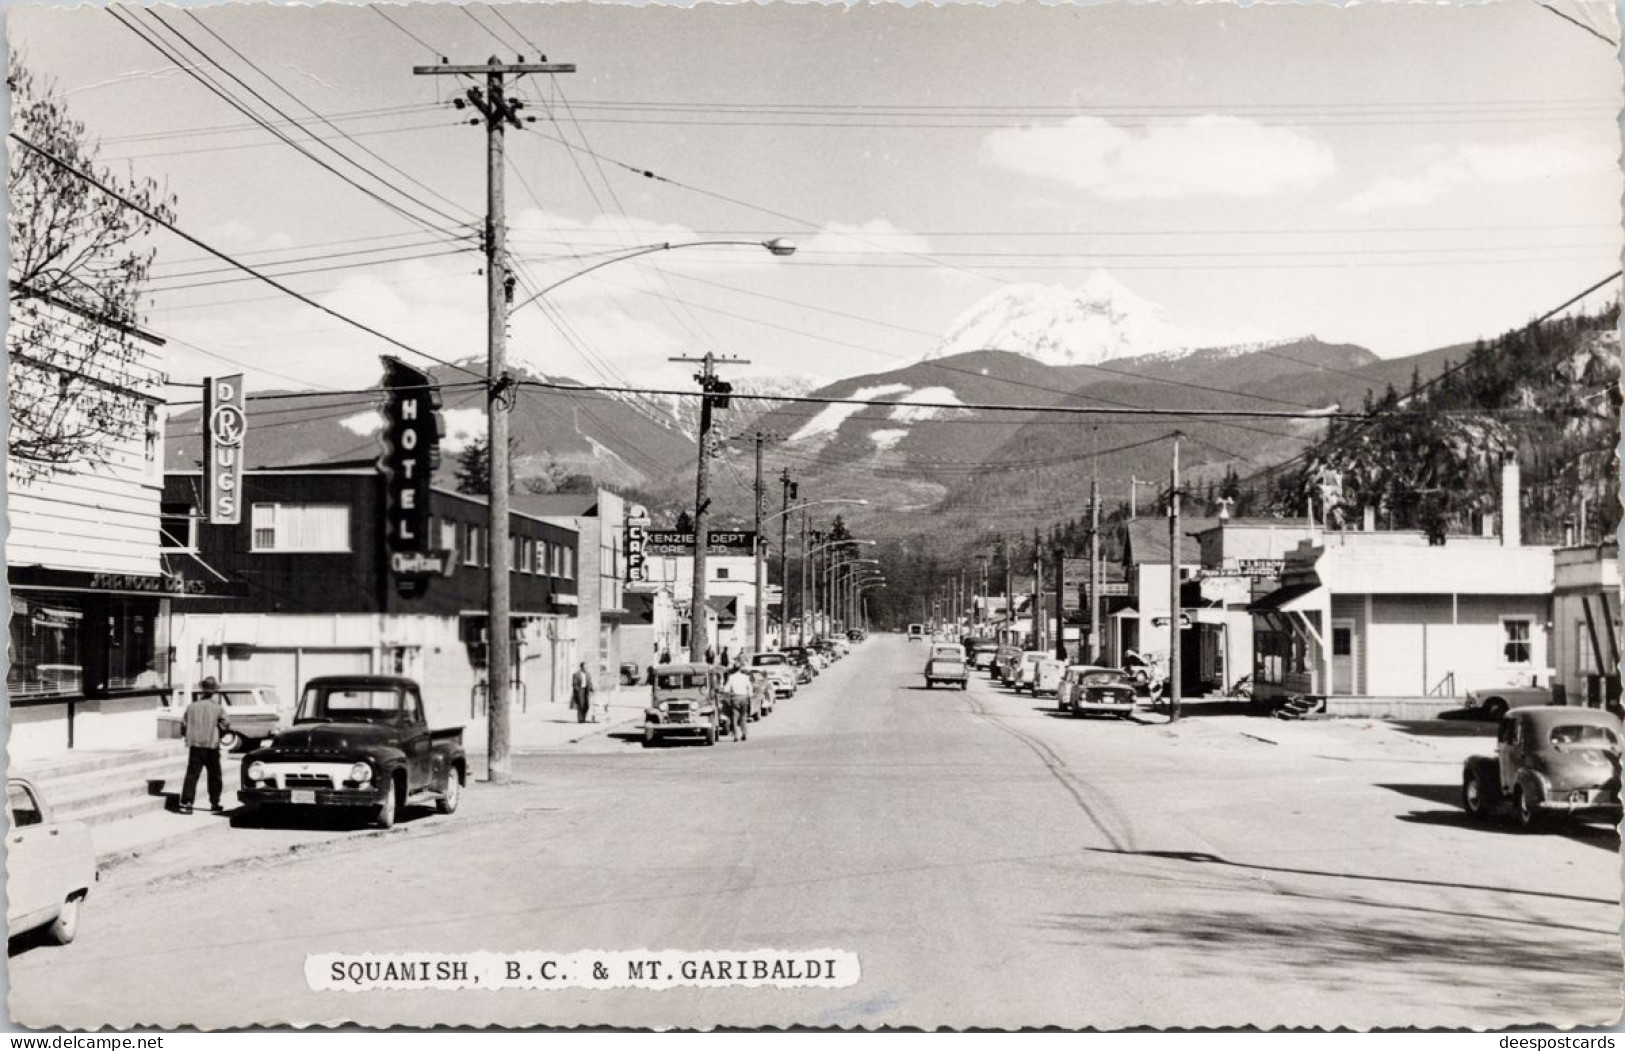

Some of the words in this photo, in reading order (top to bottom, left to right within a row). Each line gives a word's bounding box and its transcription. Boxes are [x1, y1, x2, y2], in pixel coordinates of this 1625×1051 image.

[400, 399, 418, 540] HOTEL
[629, 526, 641, 580] CAFE
[646, 544, 686, 554] STORE
[710, 533, 746, 544] DEPT
